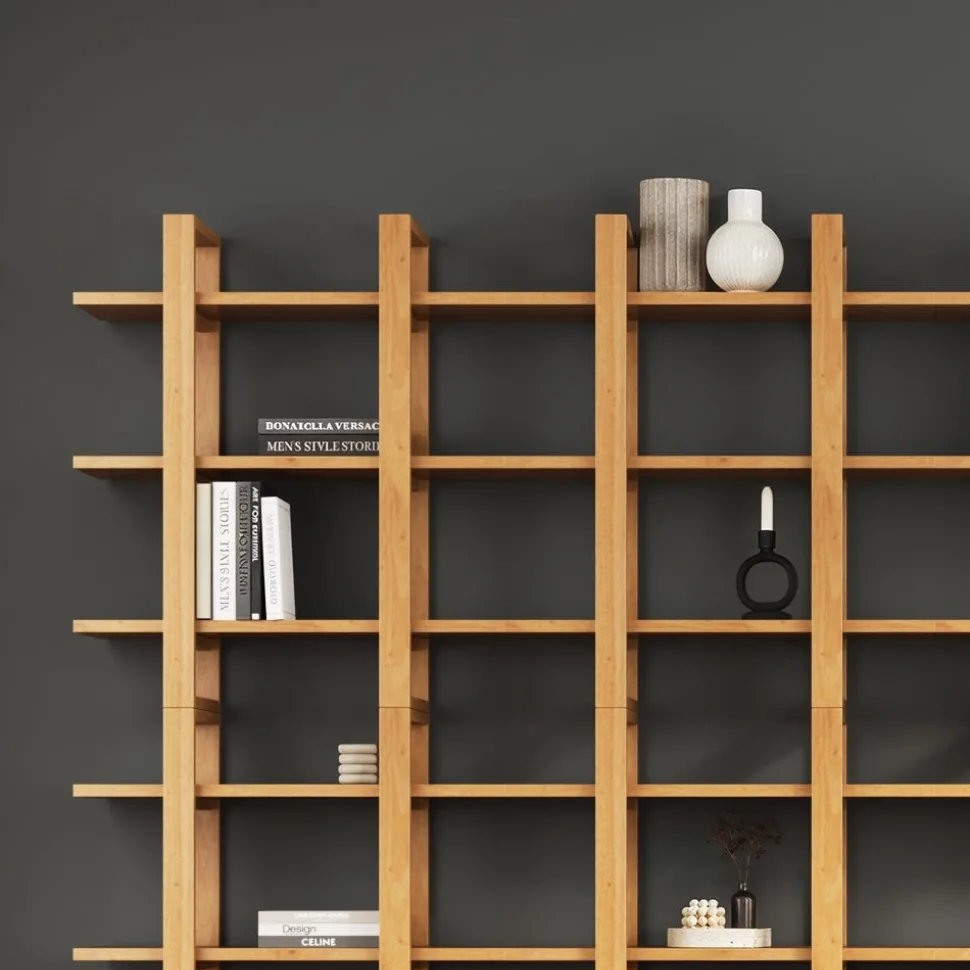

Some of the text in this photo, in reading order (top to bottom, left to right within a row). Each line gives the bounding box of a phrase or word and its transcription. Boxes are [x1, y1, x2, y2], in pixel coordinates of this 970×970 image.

[334, 421, 379, 431] VERSAC
[341, 440, 379, 452] STORI
[282, 924, 317, 936] Design
[301, 938, 336, 947] CELINE
